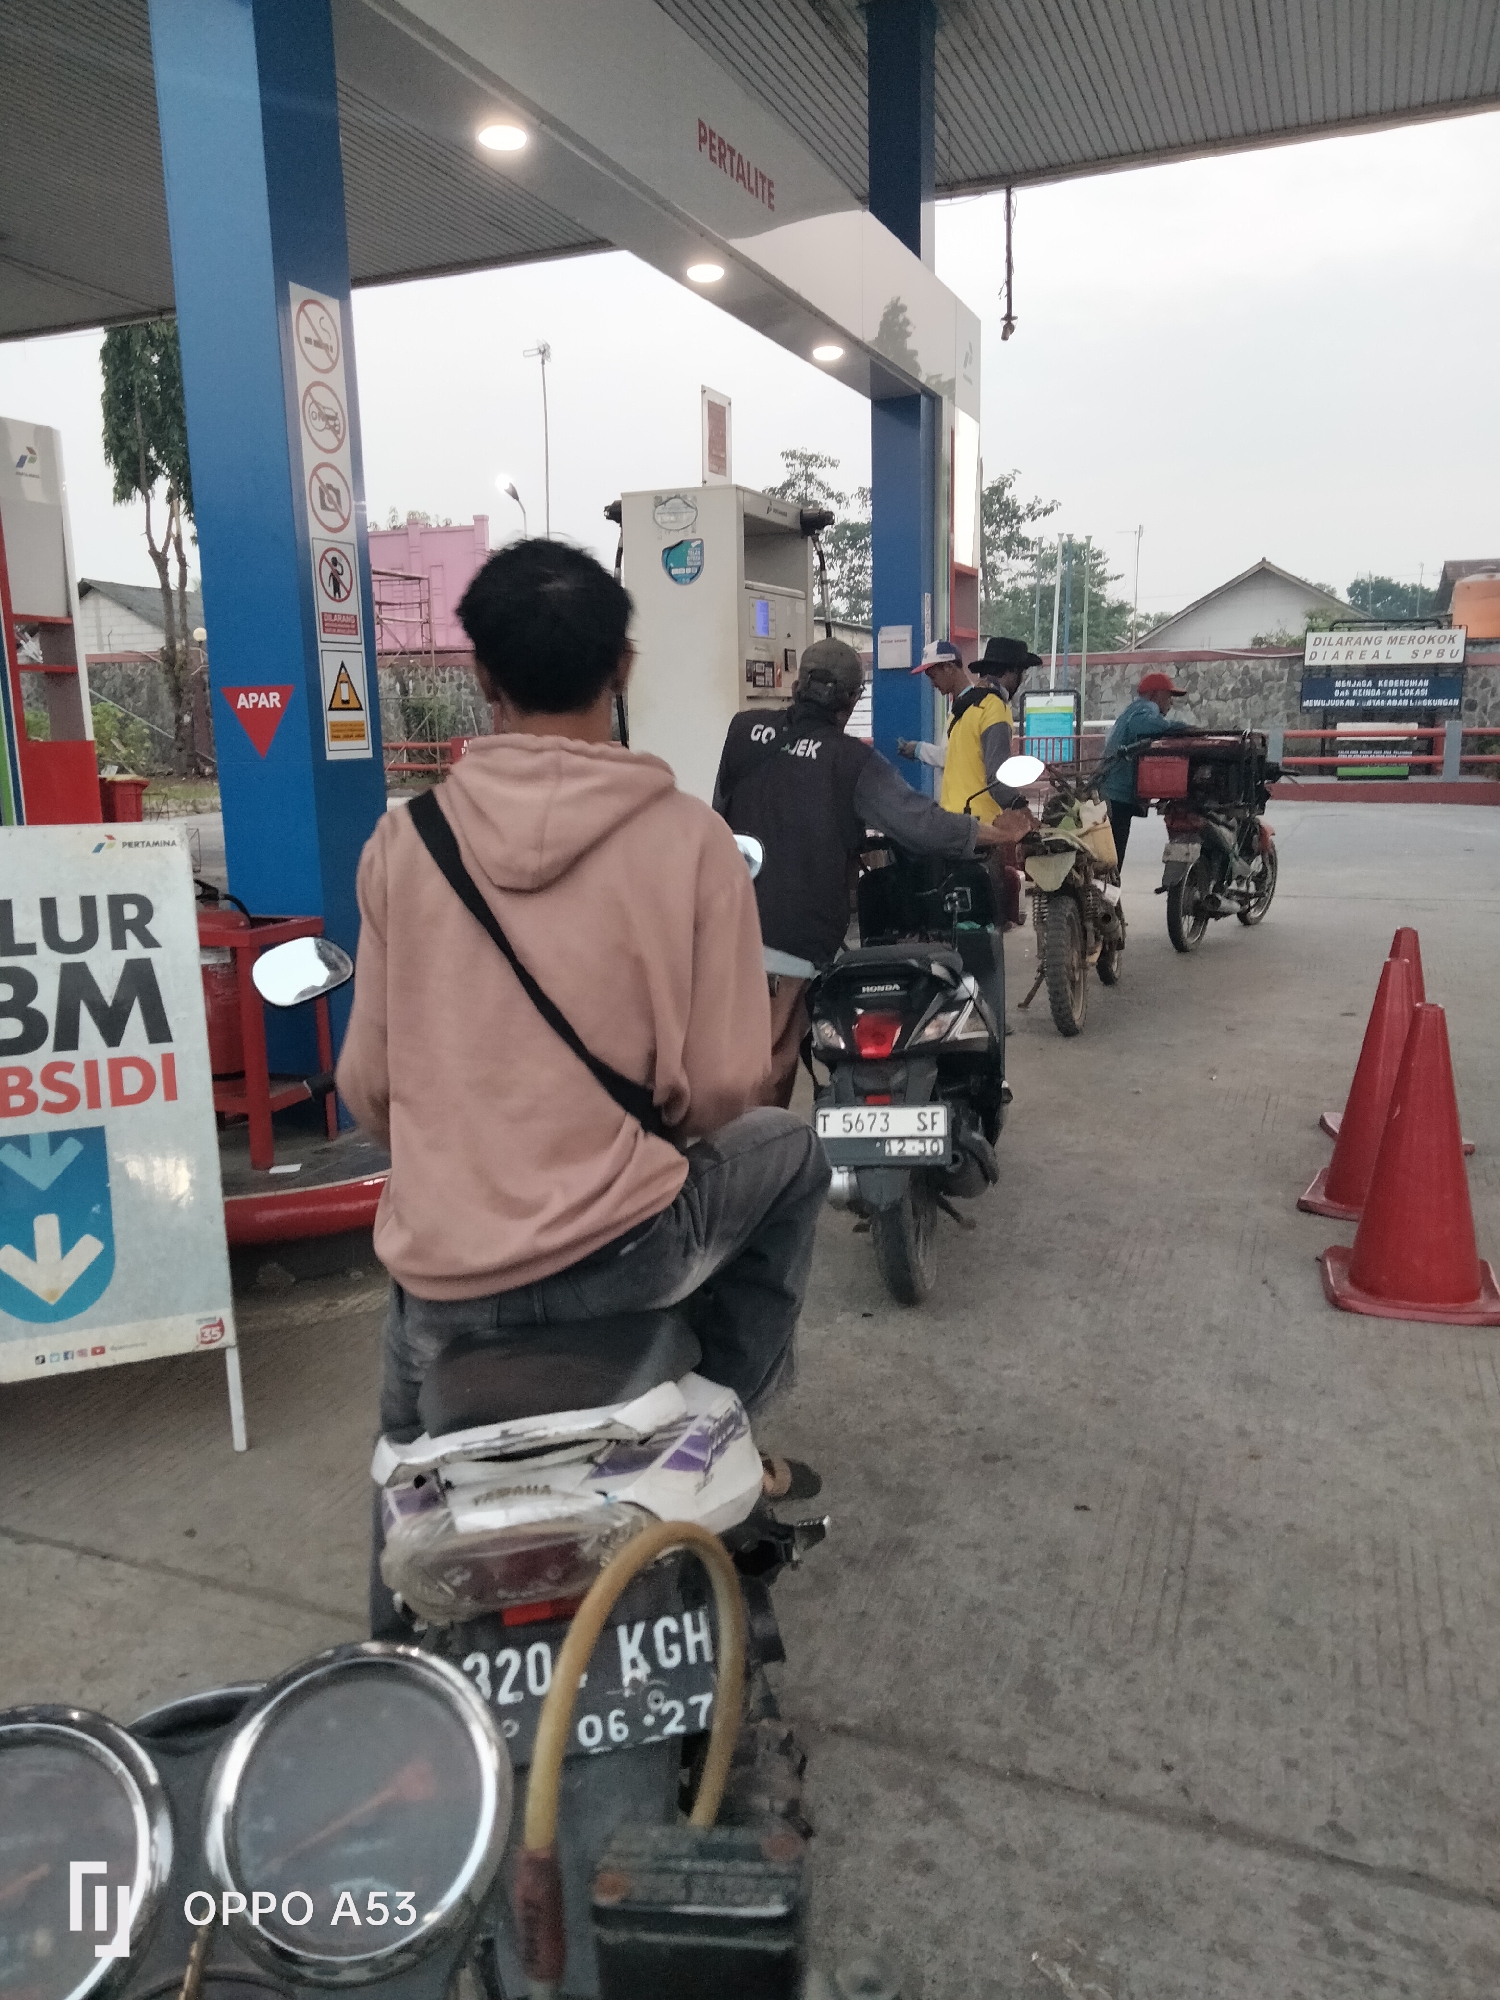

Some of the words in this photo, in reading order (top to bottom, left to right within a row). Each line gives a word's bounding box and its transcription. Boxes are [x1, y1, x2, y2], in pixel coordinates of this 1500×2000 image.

[697, 117, 775, 212] PERTALITE
[1313, 635, 1383, 647] DILARANG
[1386, 634, 1458, 645] MEROKOK
[1411, 649, 1460, 659] SPBU
[237, 691, 282, 709] APAR
[750, 723, 776, 745] GO
[121, 839, 177, 849] PERTAMINA
[861, 983, 901, 993] HONDA
[819, 1113, 830, 1133] T
[842, 1111, 890, 1134] 5673
[917, 1111, 941, 1132] SF
[616, 1609, 714, 1698] KGH
